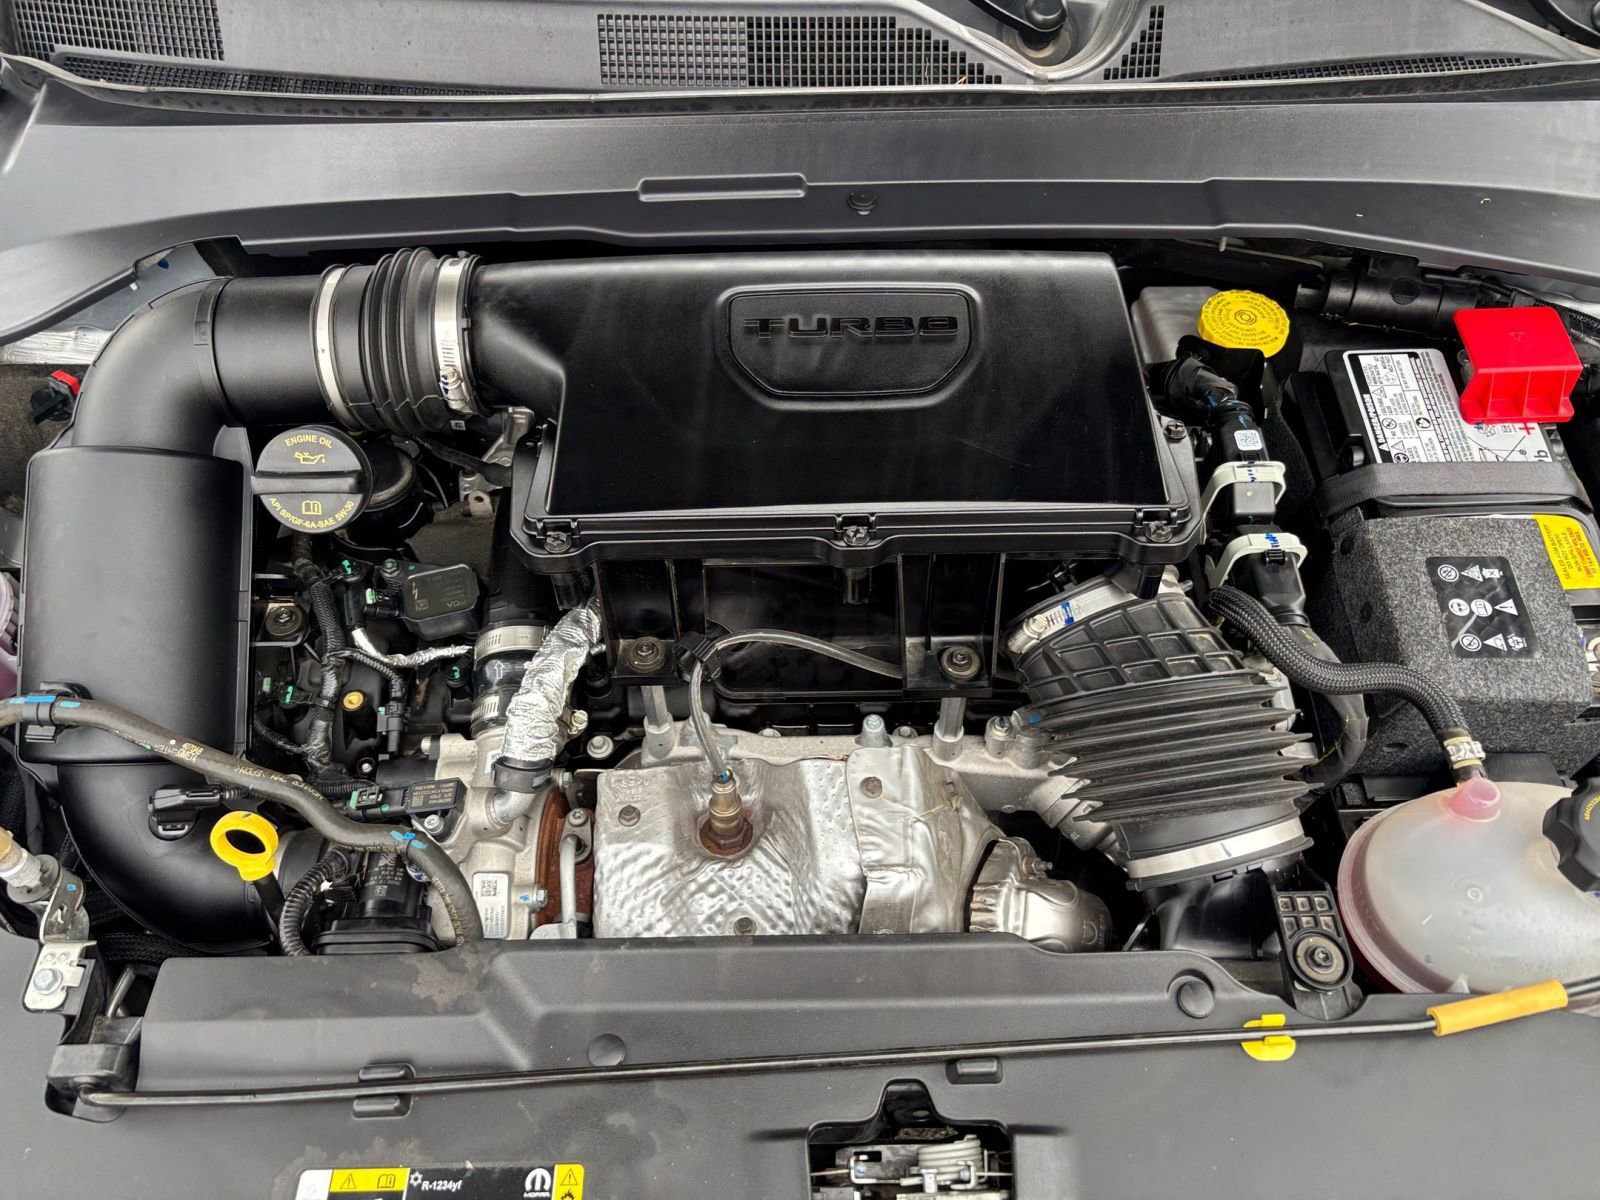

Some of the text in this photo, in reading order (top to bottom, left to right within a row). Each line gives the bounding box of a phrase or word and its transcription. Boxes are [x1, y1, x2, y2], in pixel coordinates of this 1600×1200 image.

[743, 315, 959, 339] TURBO
[284, 434, 334, 449] ENGINE OIL
[269, 497, 282, 511] API
[335, 500, 354, 521] 5W-30
[421, 1180, 463, 1193] R-1234yf
